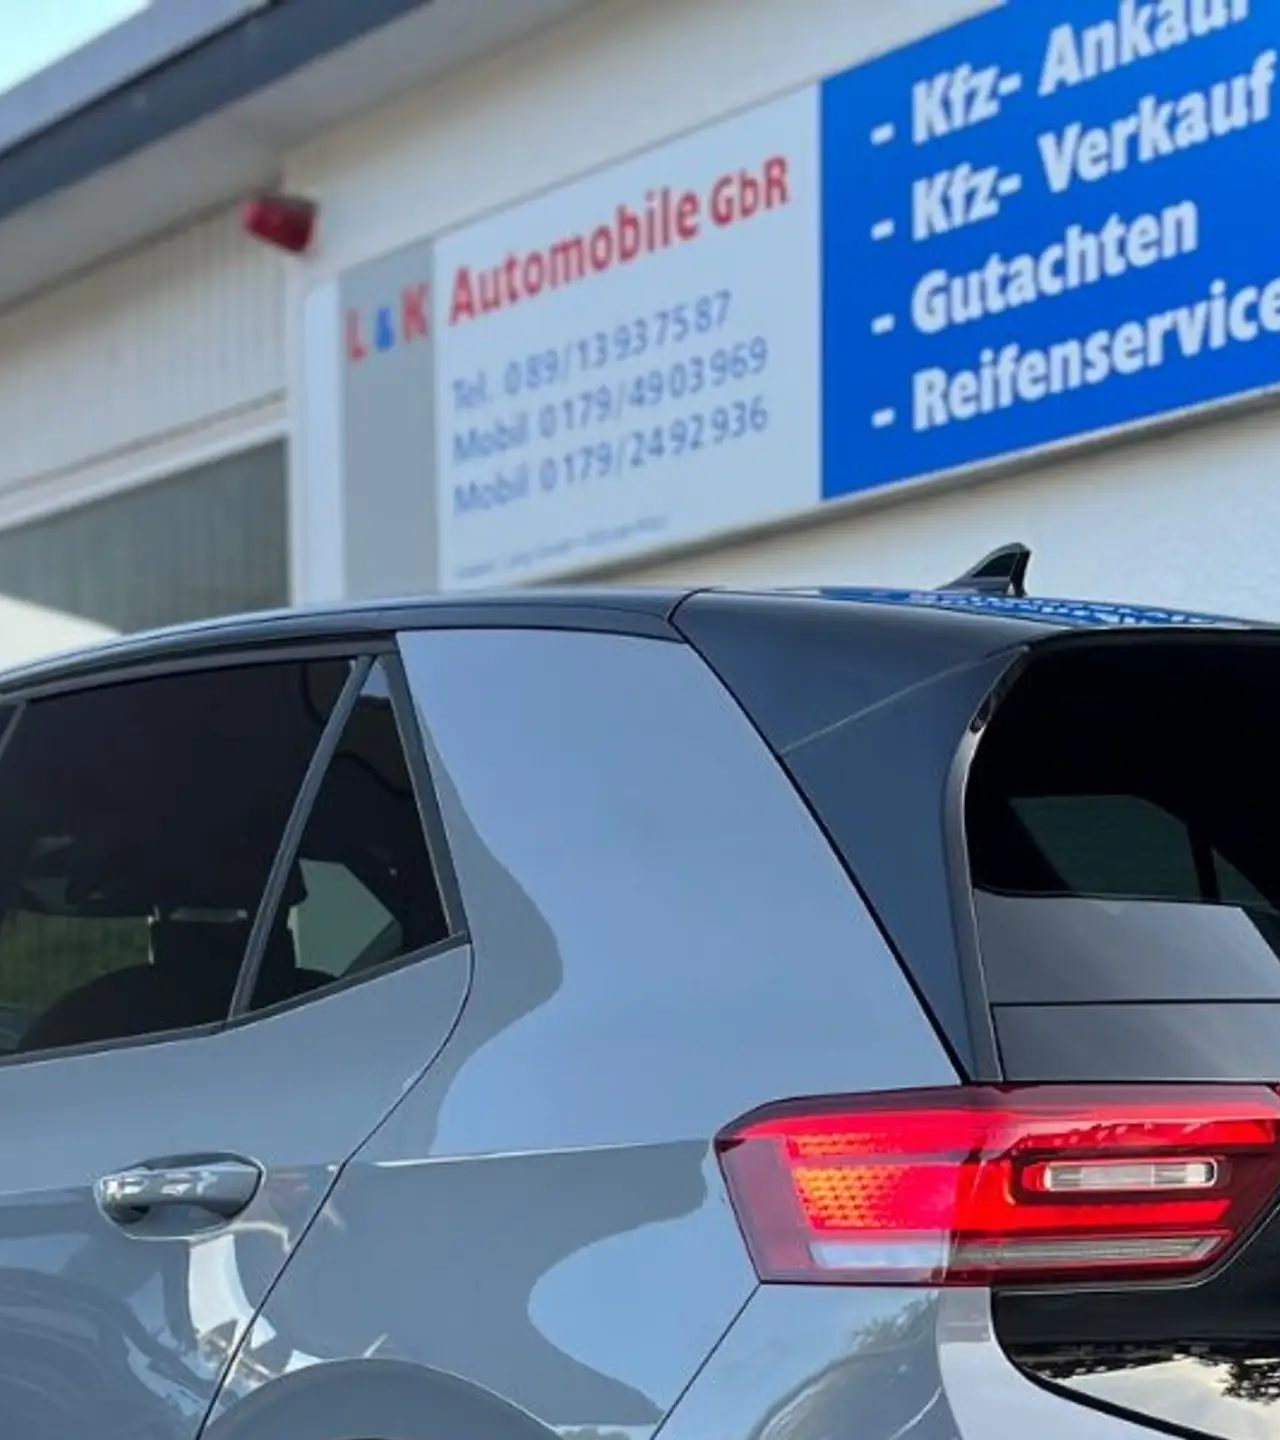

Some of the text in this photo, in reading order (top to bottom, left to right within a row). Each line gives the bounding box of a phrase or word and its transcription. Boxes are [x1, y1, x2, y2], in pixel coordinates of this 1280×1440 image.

[912, 64, 1022, 143] Kfz-
[912, 163, 1022, 241] Kfz-
[1038, 50, 1278, 193] Verkauf
[448, 187, 701, 326] Automobile
[708, 155, 790, 227] GbR
[912, 200, 1198, 333] Gutachten
[454, 411, 527, 463] Mobil
[454, 462, 528, 514] Mobil
